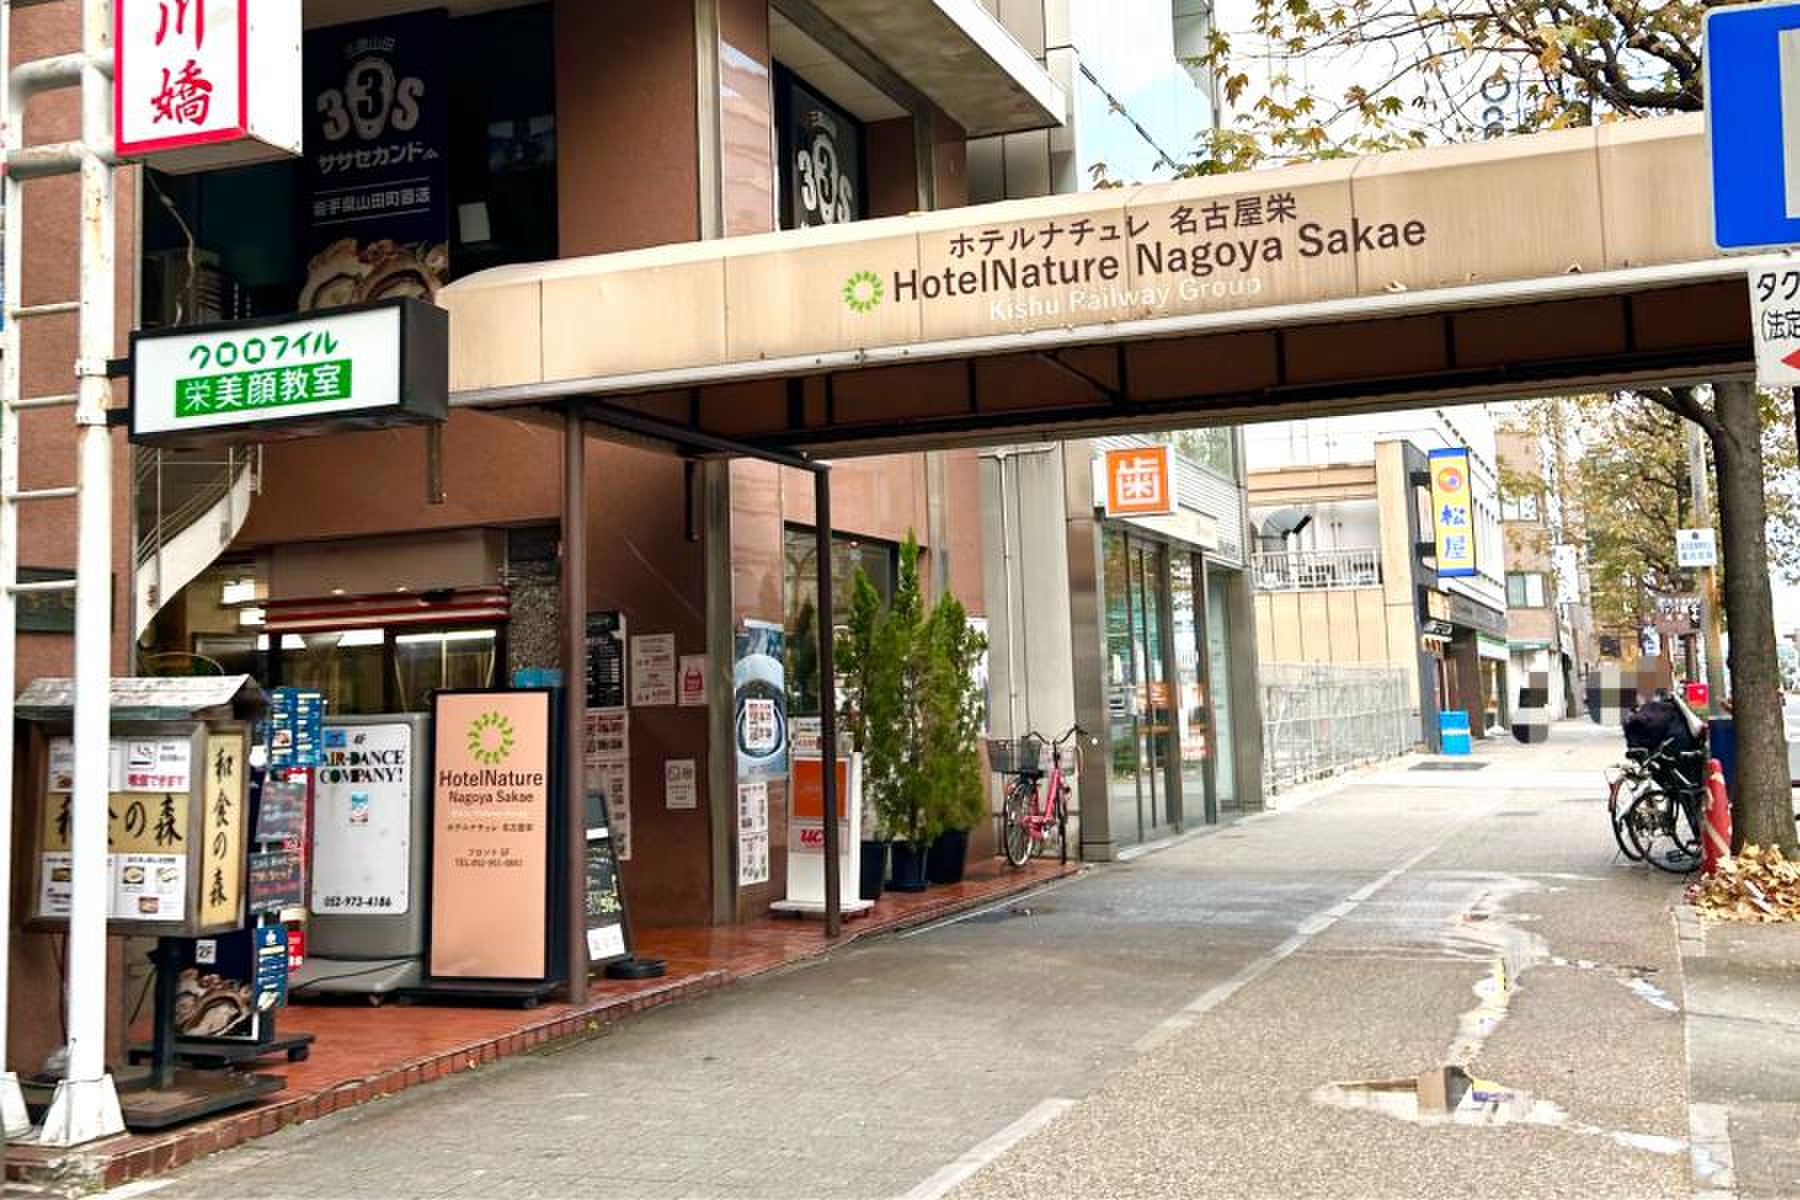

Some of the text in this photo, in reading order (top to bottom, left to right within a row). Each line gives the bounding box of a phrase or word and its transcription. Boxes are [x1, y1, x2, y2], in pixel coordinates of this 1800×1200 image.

[948, 192, 1298, 259] ホテルナチュレ 名古屋栄
[893, 216, 1428, 303] HotelNature Nagoya Sakae
[989, 274, 1263, 322] Kishu Railway Group
[183, 363, 342, 412] 栄美顔教室
[1116, 457, 1162, 506] 歯
[1439, 503, 1468, 562] 松屋
[319, 767, 404, 785] COMPANY!
[439, 768, 544, 788] HotelNature
[448, 789, 534, 806] Nagoya Sakae
[208, 746, 233, 908] 和食の森
